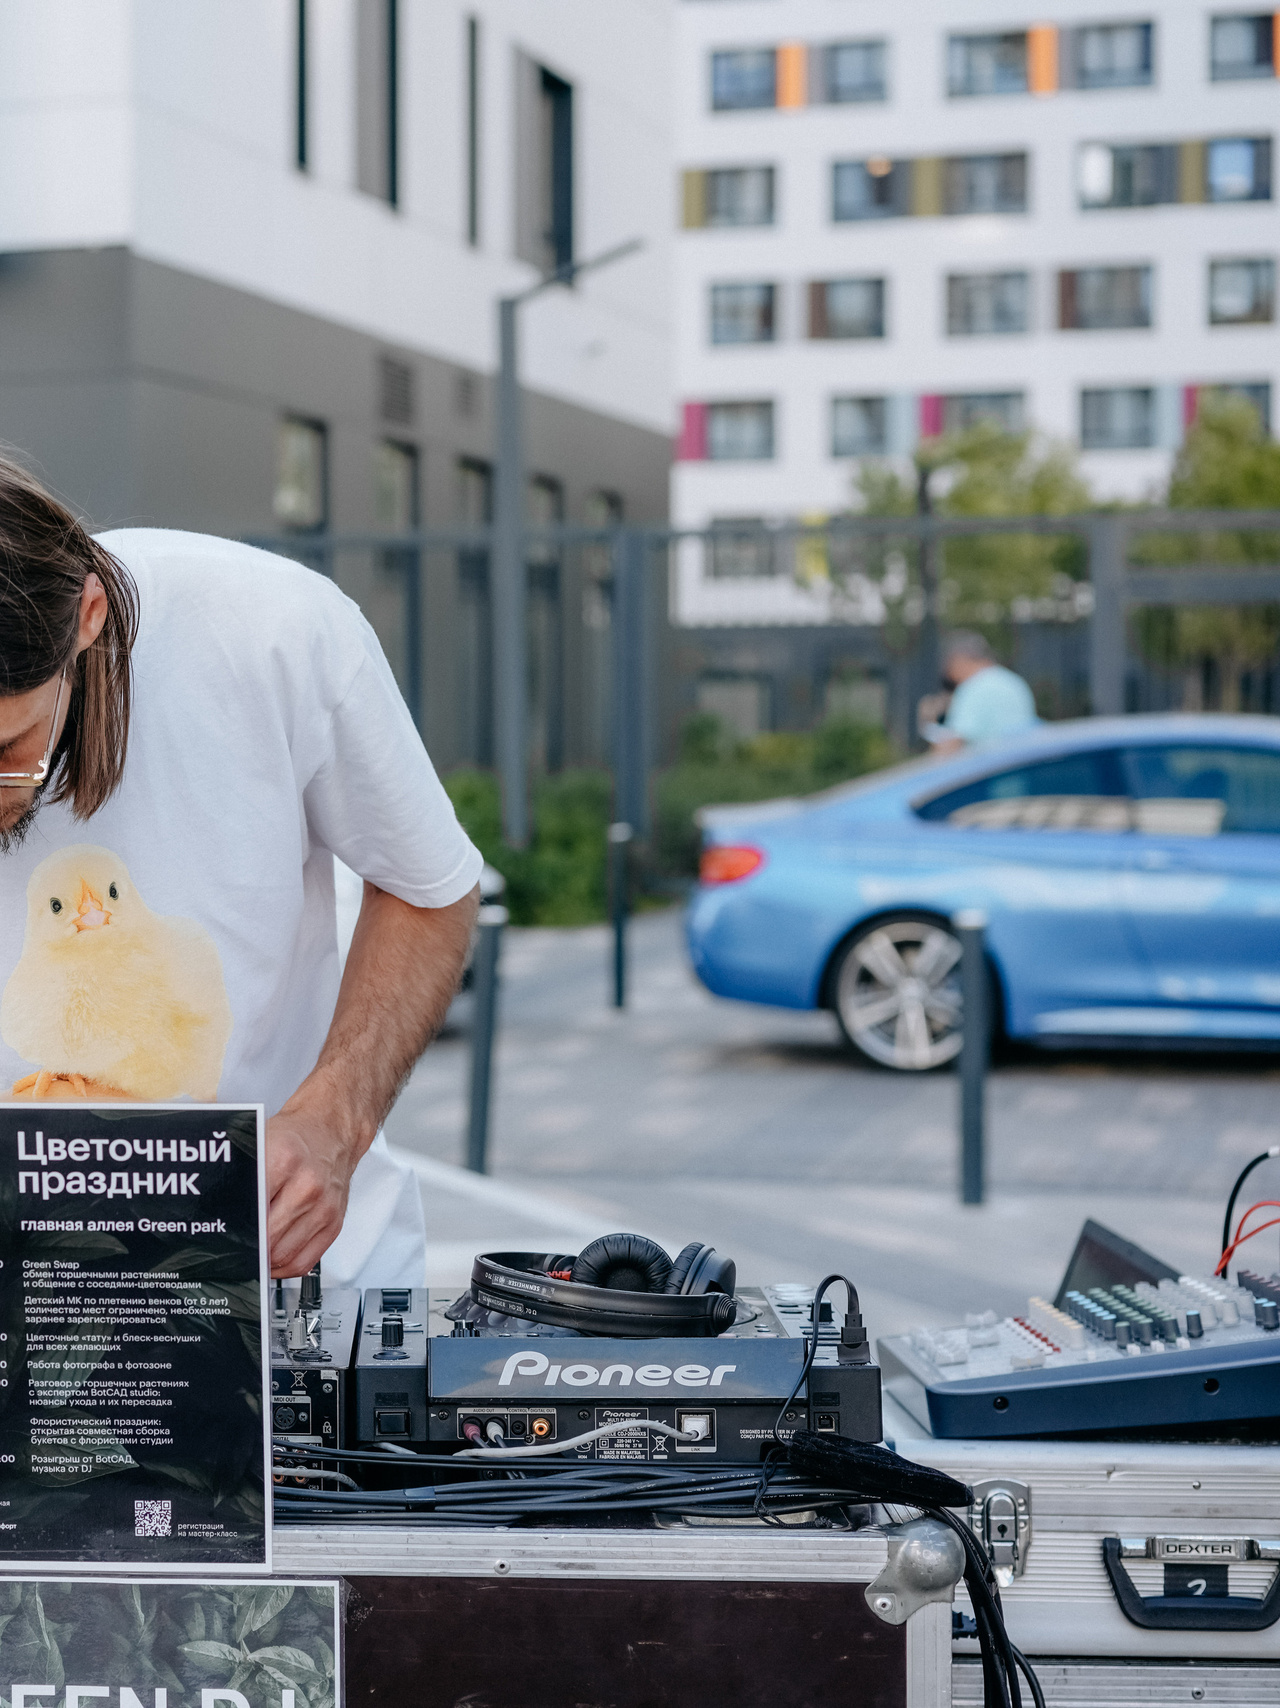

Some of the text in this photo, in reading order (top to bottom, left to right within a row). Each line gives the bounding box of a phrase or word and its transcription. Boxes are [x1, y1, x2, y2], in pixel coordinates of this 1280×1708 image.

[18, 1131, 230, 1165] Цветочный
[19, 1172, 200, 1200] праздник
[21, 1218, 226, 1234] главная аллея Green park
[22, 1260, 79, 1271] Green Swap
[23, 1270, 179, 1280] обмен горшечными растениями
[32, 1280, 76, 1288] общение
[86, 1280, 202, 1289] соседями-цветоводами
[24, 1296, 64, 1305] Детский
[67, 1296, 82, 1304] МК
[184, 1297, 197, 1306] (от
[200, 1297, 206, 1305] 6
[209, 1297, 228, 1306] лет)
[171, 1306, 230, 1315] необходимо
[26, 1316, 65, 1324] заранее
[26, 1334, 79, 1342] Цветочные
[122, 1333, 200, 1343] блеск-веснушки
[70, 1343, 121, 1351] желающих
[63, 1361, 115, 1370] фотографа
[125, 1361, 172, 1370] фотозоне
[497, 1350, 737, 1387] Pioneer
[28, 1379, 72, 1388] Разговор
[83, 1380, 136, 1388] горшечных
[140, 1380, 189, 1388] растениях
[37, 1389, 88, 1397] экспертом
[30, 1418, 111, 1426] Флористический
[31, 1427, 170, 1436] открытая совместная сборка
[31, 1436, 68, 1445] букетов
[79, 1436, 137, 1446] флористами
[140, 1436, 173, 1445] студии
[32, 1455, 80, 1464] Розыгрыш
[32, 1464, 65, 1474] музыка
[81, 1464, 92, 1472] DJ
[1166, 1544, 1232, 1554] DEXTER
